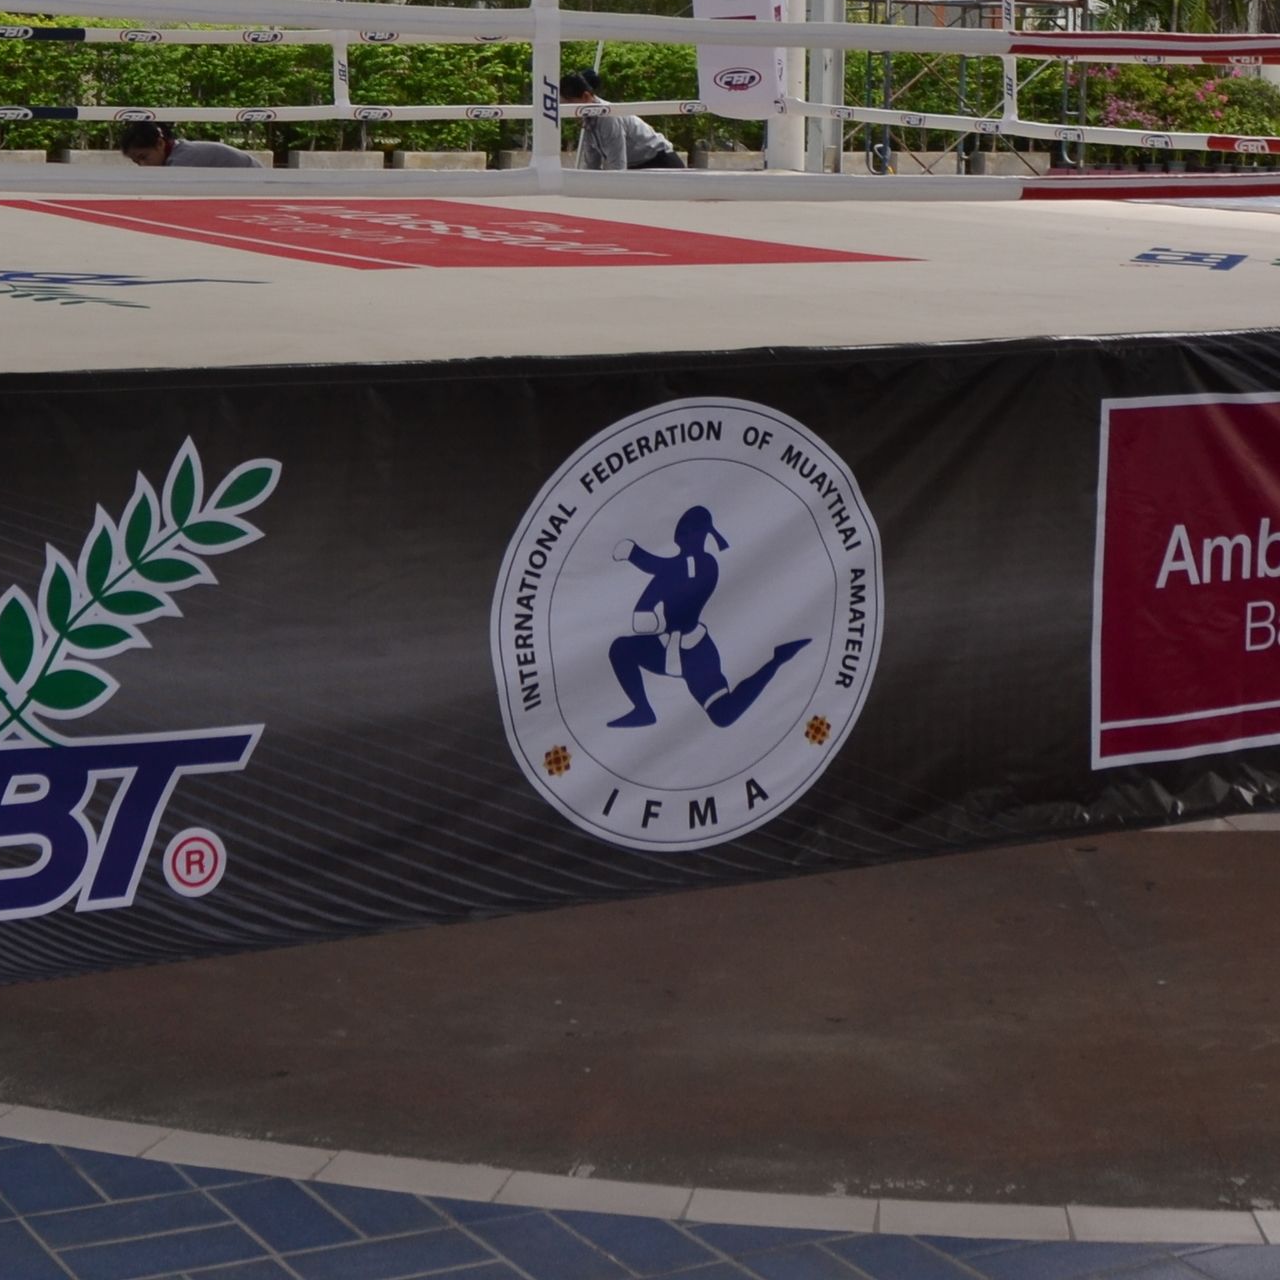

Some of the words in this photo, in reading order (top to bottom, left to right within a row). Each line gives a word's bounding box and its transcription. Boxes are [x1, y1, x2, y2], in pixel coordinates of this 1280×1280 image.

[543, 76, 559, 128] FBT
[513, 503, 577, 712] INTERNATIONAL
[579, 420, 722, 494] FEDERATION
[742, 426, 773, 451] OF
[780, 444, 862, 552] MUAYTHAI
[834, 567, 866, 690] AMATEUR
[601, 777, 769, 829] IFMA
